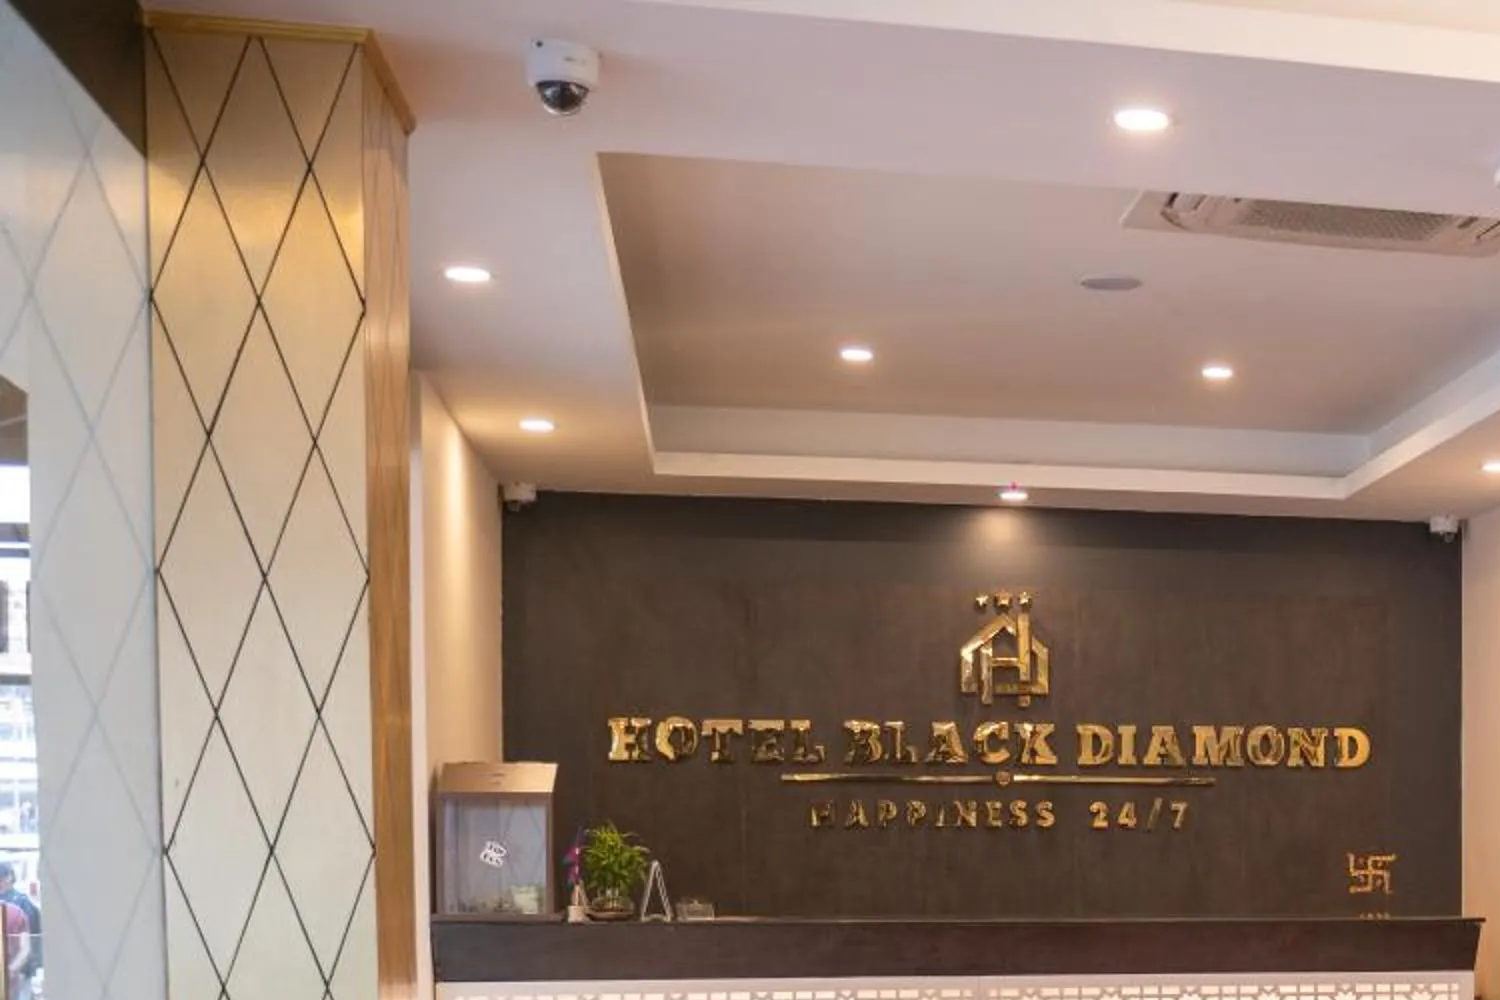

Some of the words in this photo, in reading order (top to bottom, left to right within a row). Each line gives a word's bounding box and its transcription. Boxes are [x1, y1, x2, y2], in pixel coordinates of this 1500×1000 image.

[607, 716, 826, 762] HOTEL
[843, 719, 1058, 765] BLACK
[1076, 723, 1371, 768] DIAMOND
[810, 798, 1056, 828] HAPPINESS
[1088, 797, 1190, 830] 24/7
